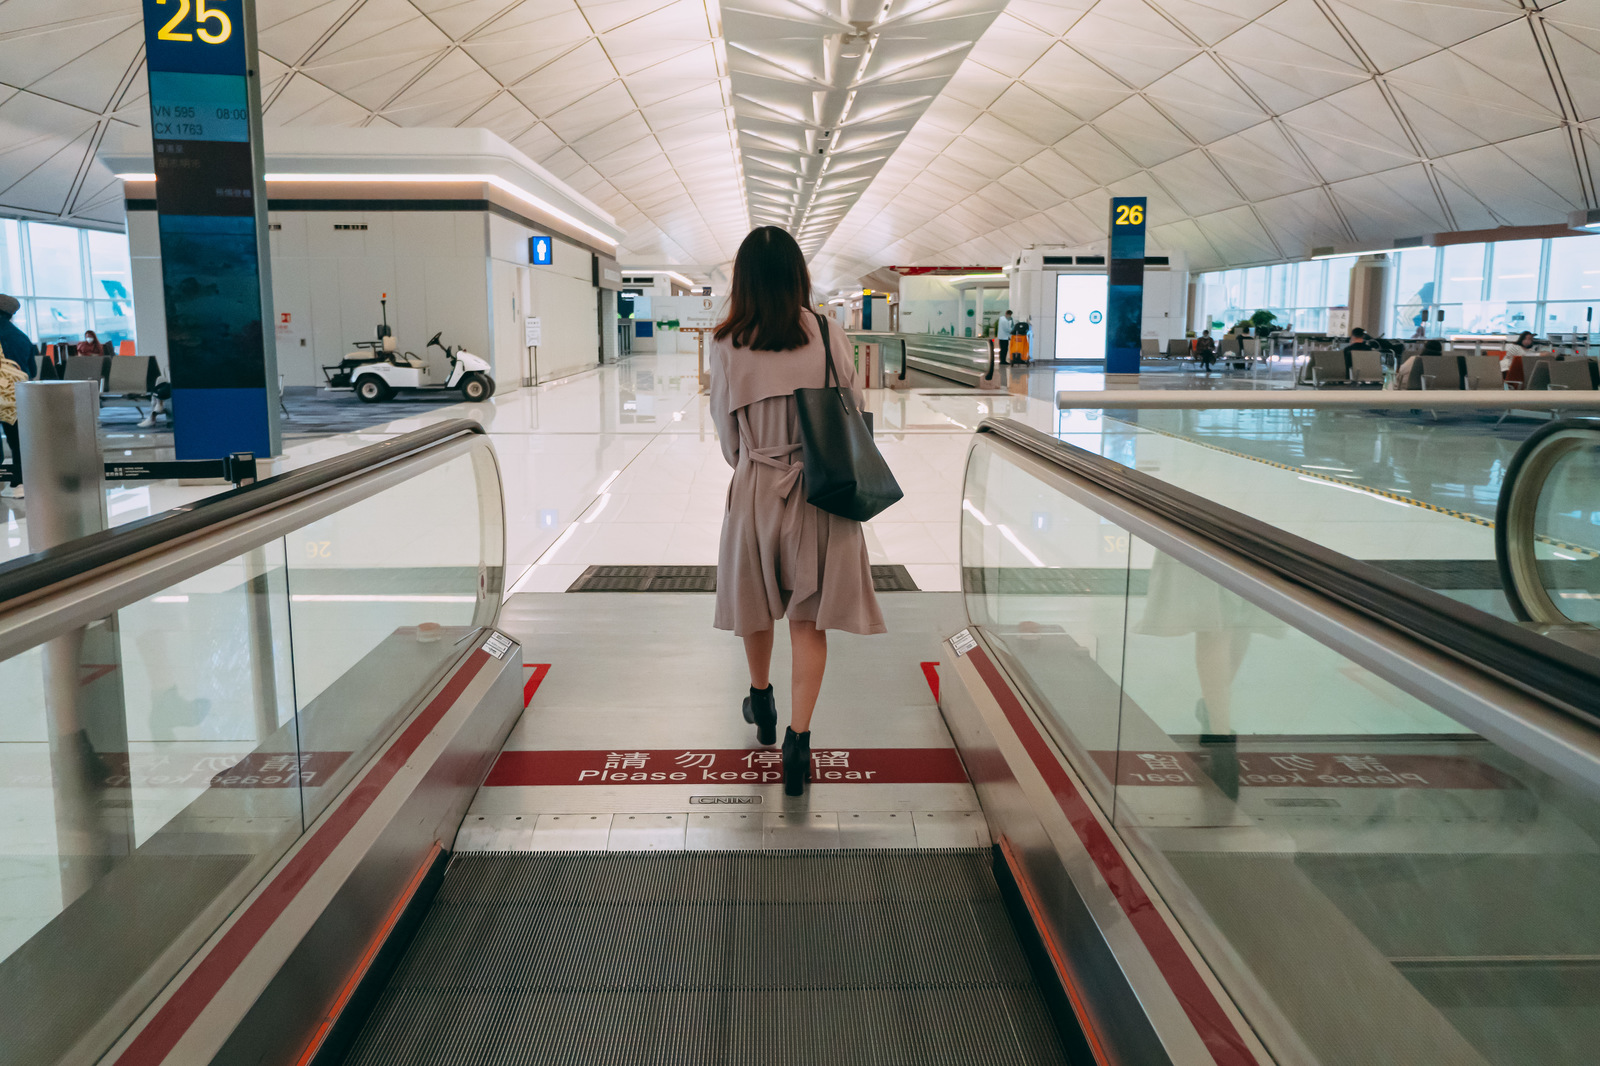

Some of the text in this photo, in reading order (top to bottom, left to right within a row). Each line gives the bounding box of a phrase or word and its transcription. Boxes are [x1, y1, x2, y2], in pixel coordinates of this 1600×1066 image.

[156, 0, 232, 45] 25
[153, 106, 248, 121] VN 595 08:00
[155, 123, 203, 136] CX 1763
[1115, 204, 1144, 226] 26
[605, 751, 850, 769] 請勿停留
[578, 768, 877, 782] Please keep lear
